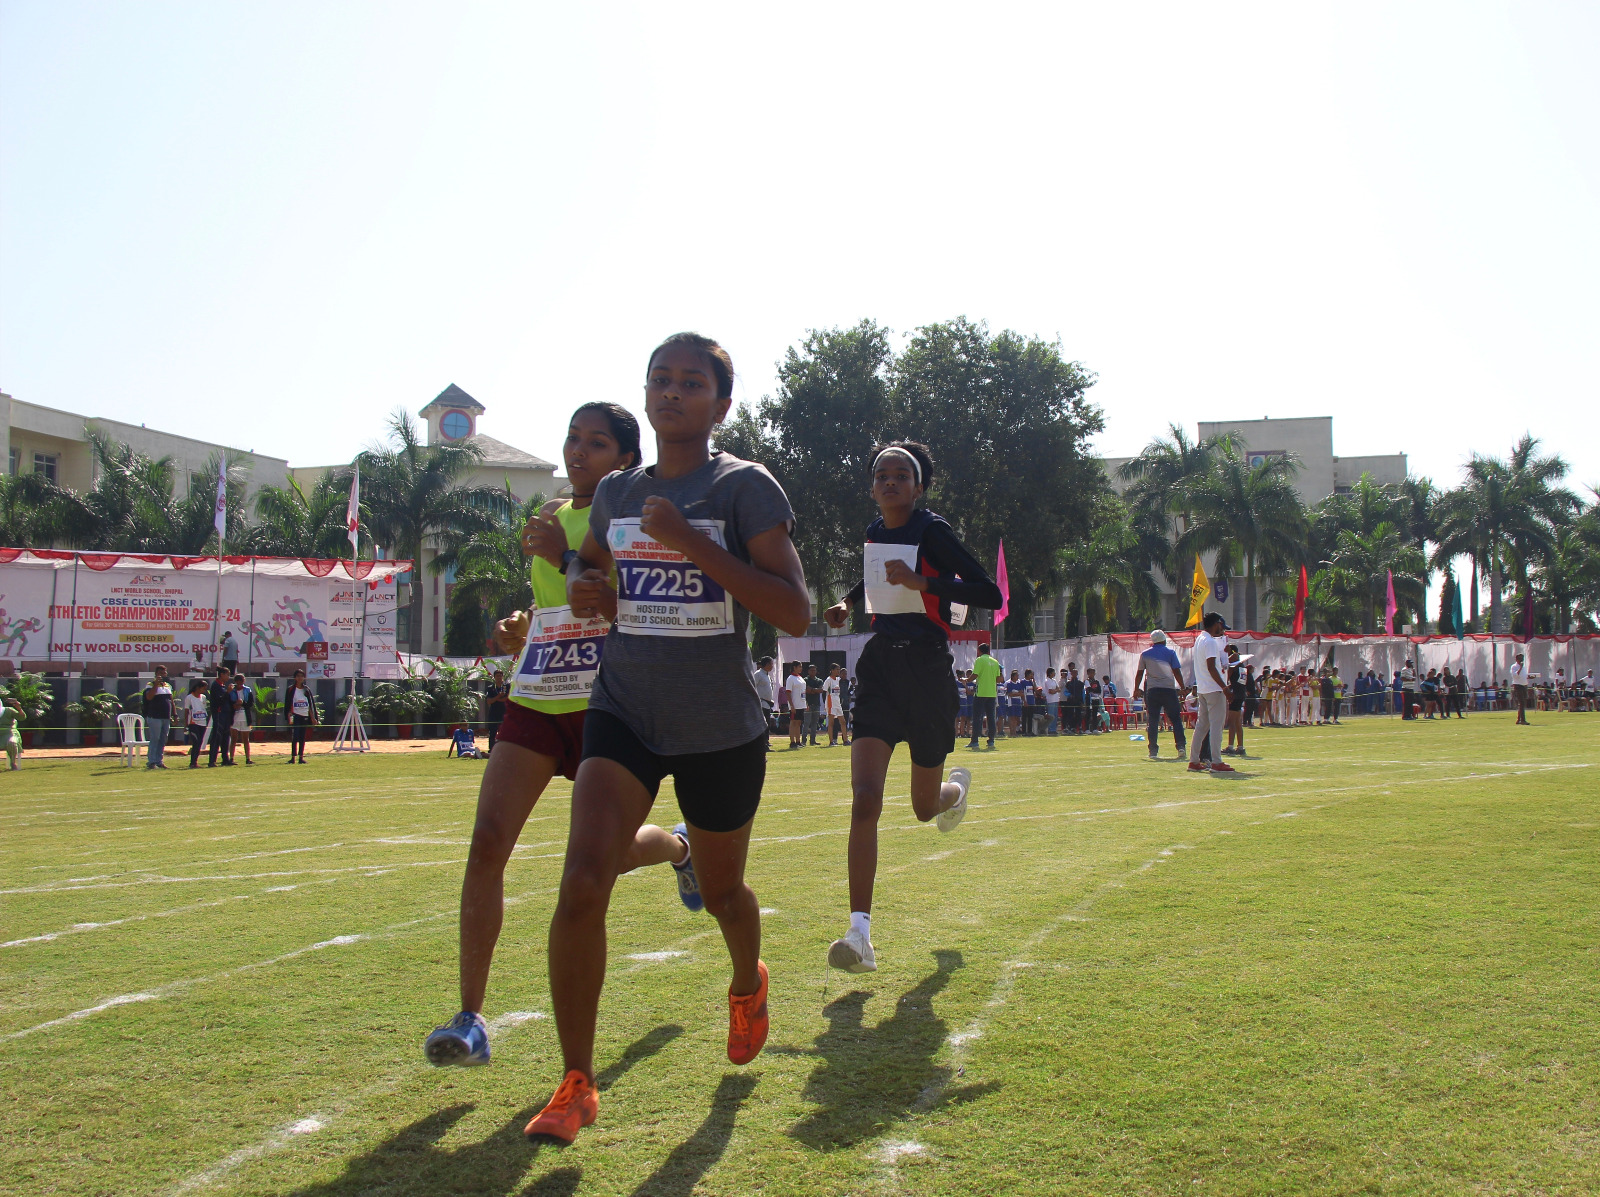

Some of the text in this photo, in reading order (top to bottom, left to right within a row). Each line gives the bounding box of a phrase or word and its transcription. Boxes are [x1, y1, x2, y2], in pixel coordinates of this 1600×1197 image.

[620, 567, 704, 597] 17225
[179, 599, 193, 607] XII
[48, 605, 101, 619] ATHLETIC
[104, 606, 189, 621] CHAMPIONSHIP
[636, 605, 680, 614] HOSTED BY
[686, 617, 720, 626] BHOPAL
[47, 643, 82, 653] LNCT
[85, 643, 132, 653] WORLD
[134, 643, 189, 655] SCHOOL,
[532, 641, 598, 670] 17243
[541, 675, 568, 684] HOSTED
